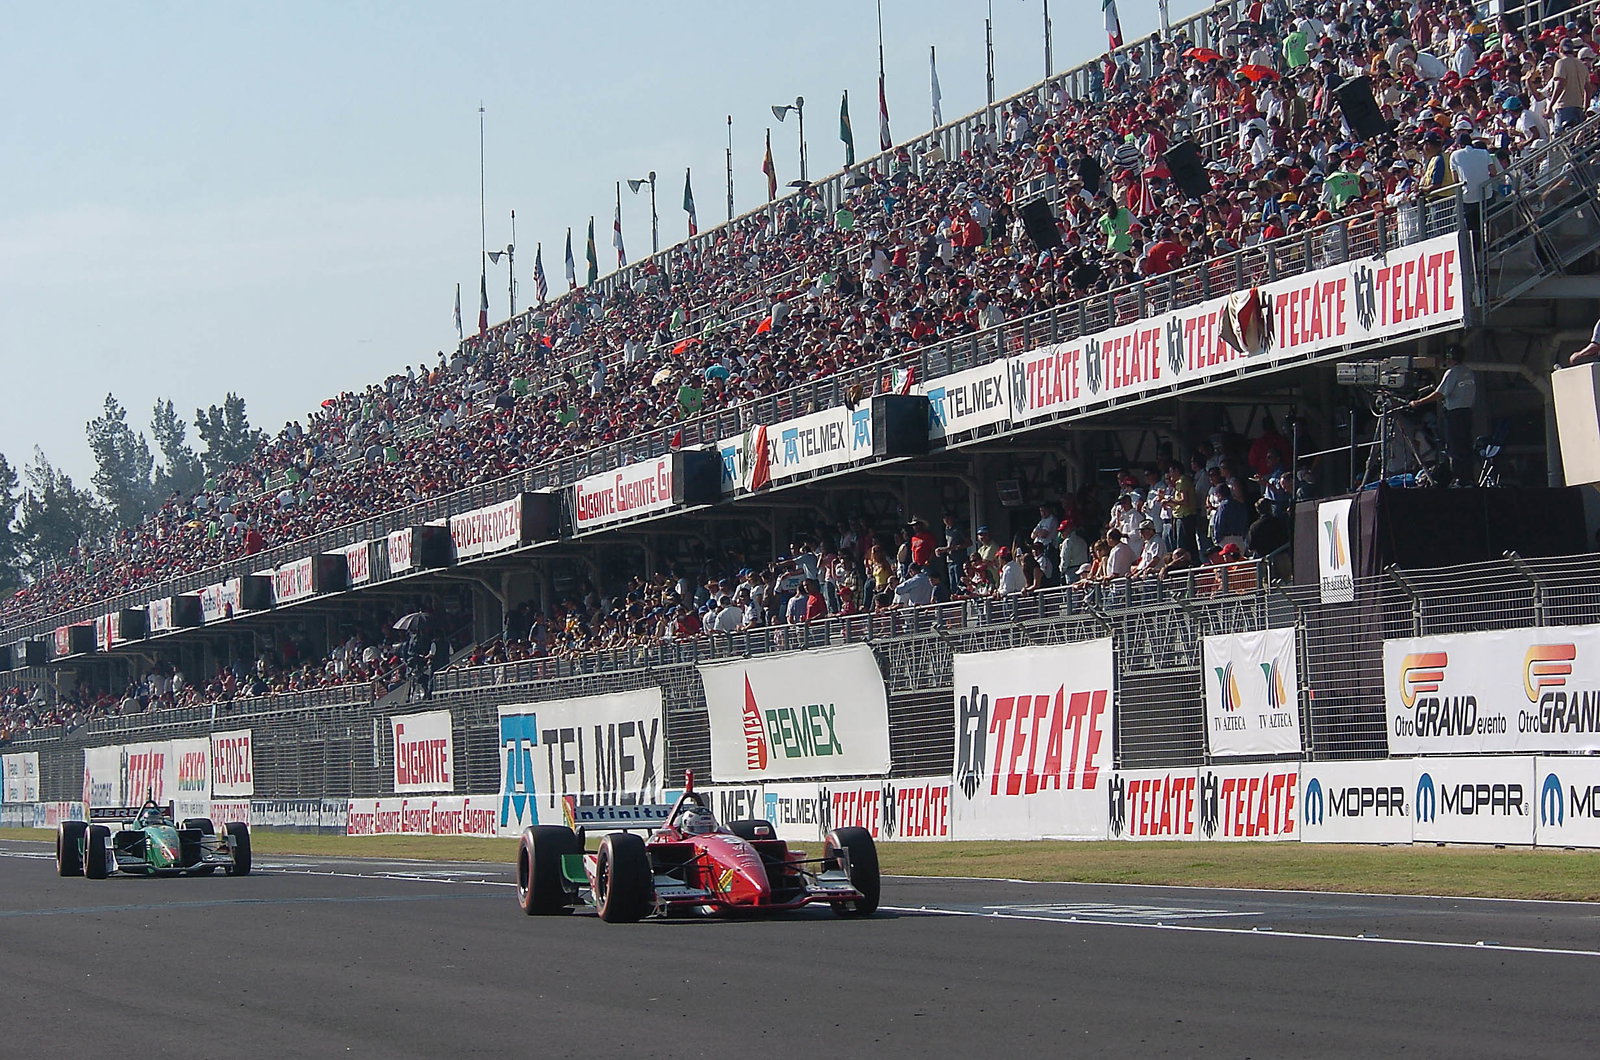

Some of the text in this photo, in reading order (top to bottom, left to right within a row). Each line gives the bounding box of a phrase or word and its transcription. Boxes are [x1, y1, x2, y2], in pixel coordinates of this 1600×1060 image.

[1027, 250, 1455, 410] TECATE TECATE TECA TECATE TECATE
[947, 375, 1003, 419] TELMEX
[799, 421, 846, 456] TELMEX
[577, 484, 615, 521] GIGANTE
[616, 473, 655, 512] GIGANTE
[390, 532, 412, 564] HERDE
[451, 515, 481, 549] HERDEZ
[483, 506, 515, 544] HERDEZ
[765, 704, 842, 759] PEMEX
[1214, 716, 1246, 731] TV AZTECA
[1259, 713, 1293, 729] TV AZTECA
[1395, 695, 1507, 737] Otro GRAND evento
[1518, 690, 1600, 733] Otro GRAN
[396, 723, 449, 784] GIGANTE
[990, 683, 1108, 796] TECATE
[179, 752, 205, 791] MEXICO
[213, 737, 251, 787] HERDEZ
[542, 718, 658, 809] TELMEX
[463, 799, 495, 834] GIGANTE
[574, 806, 672, 820] infinitu
[778, 798, 818, 824] TELMEX
[832, 783, 949, 837] TECATE TECATE
[1128, 772, 1296, 836] TECATE TECATE
[1329, 786, 1404, 817] MOPAR
[1441, 783, 1523, 816] MOPAR
